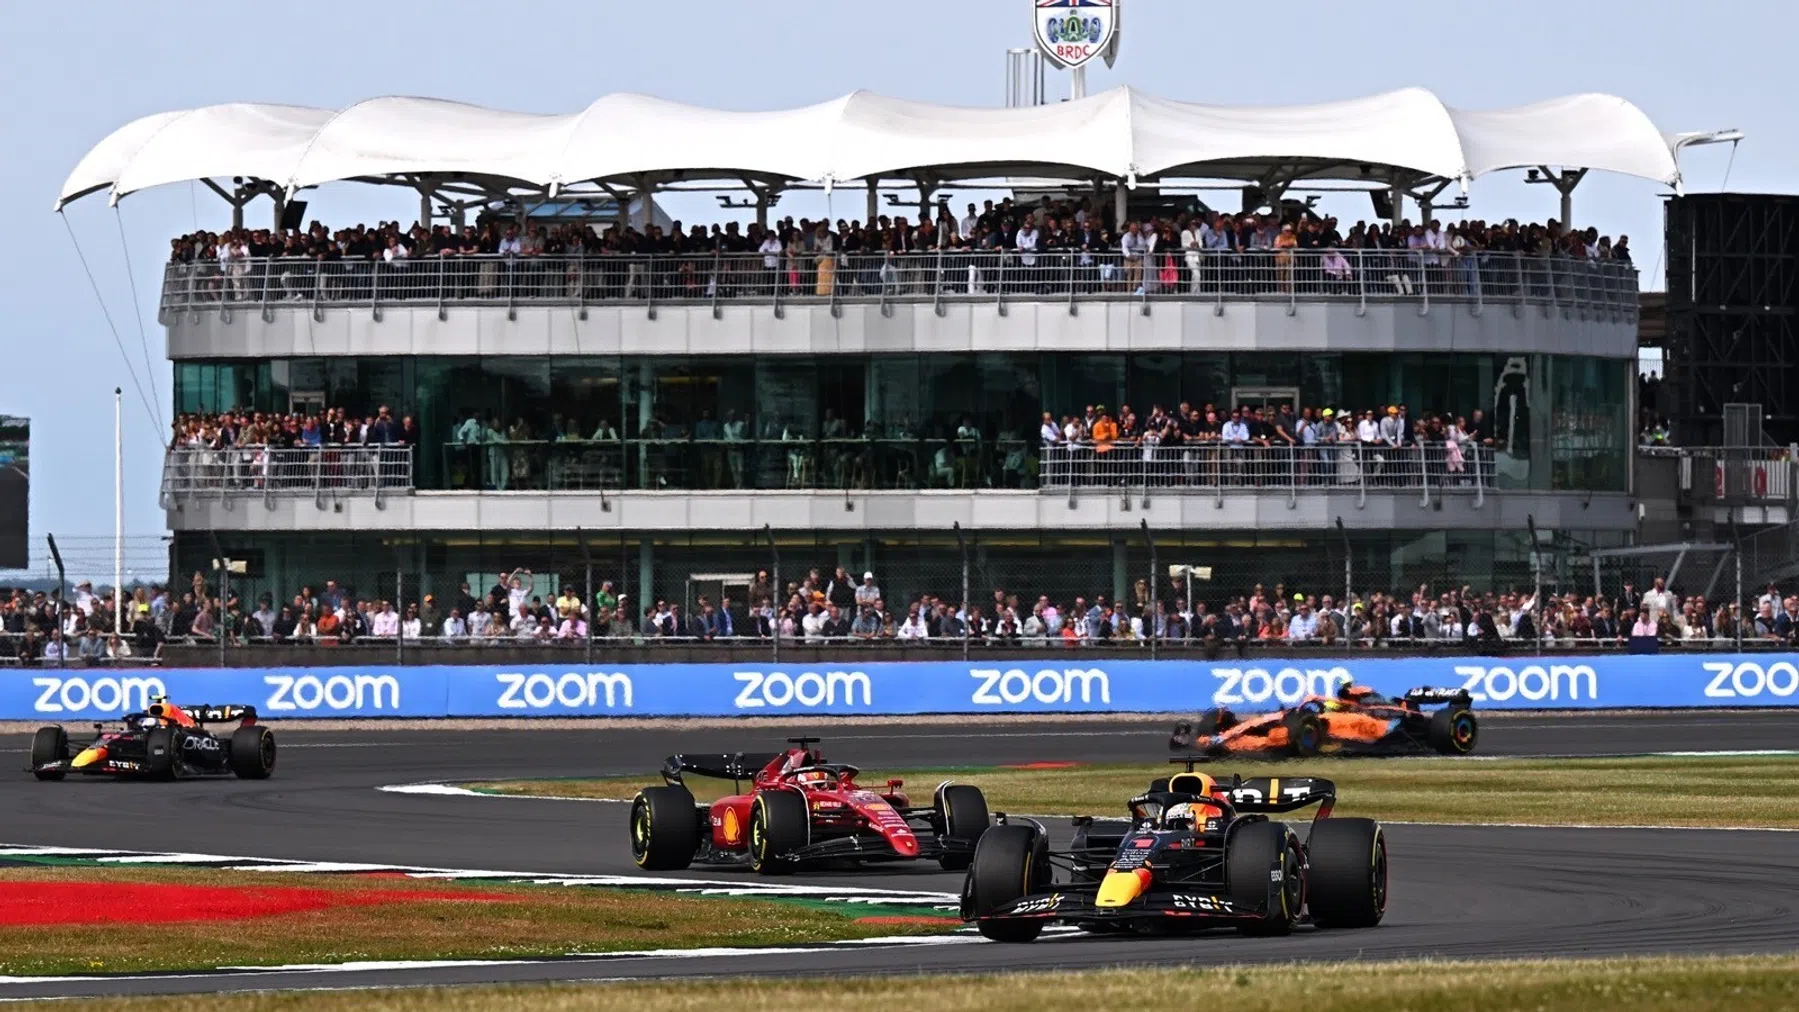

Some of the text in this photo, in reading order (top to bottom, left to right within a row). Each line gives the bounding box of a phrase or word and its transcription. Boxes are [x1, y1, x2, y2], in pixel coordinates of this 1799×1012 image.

[1057, 45, 1089, 60] BRDC
[33, 677, 166, 712] zoom
[264, 675, 399, 710] zoom
[496, 672, 633, 708] zoom
[734, 671, 871, 707] zoom
[970, 668, 1110, 704] zoom
[1211, 667, 1352, 705] zoom
[1454, 665, 1597, 701] zoom
[1702, 662, 1799, 698] zoo
[183, 736, 220, 750] ORACLE
[1172, 894, 1233, 913] BYBIT
